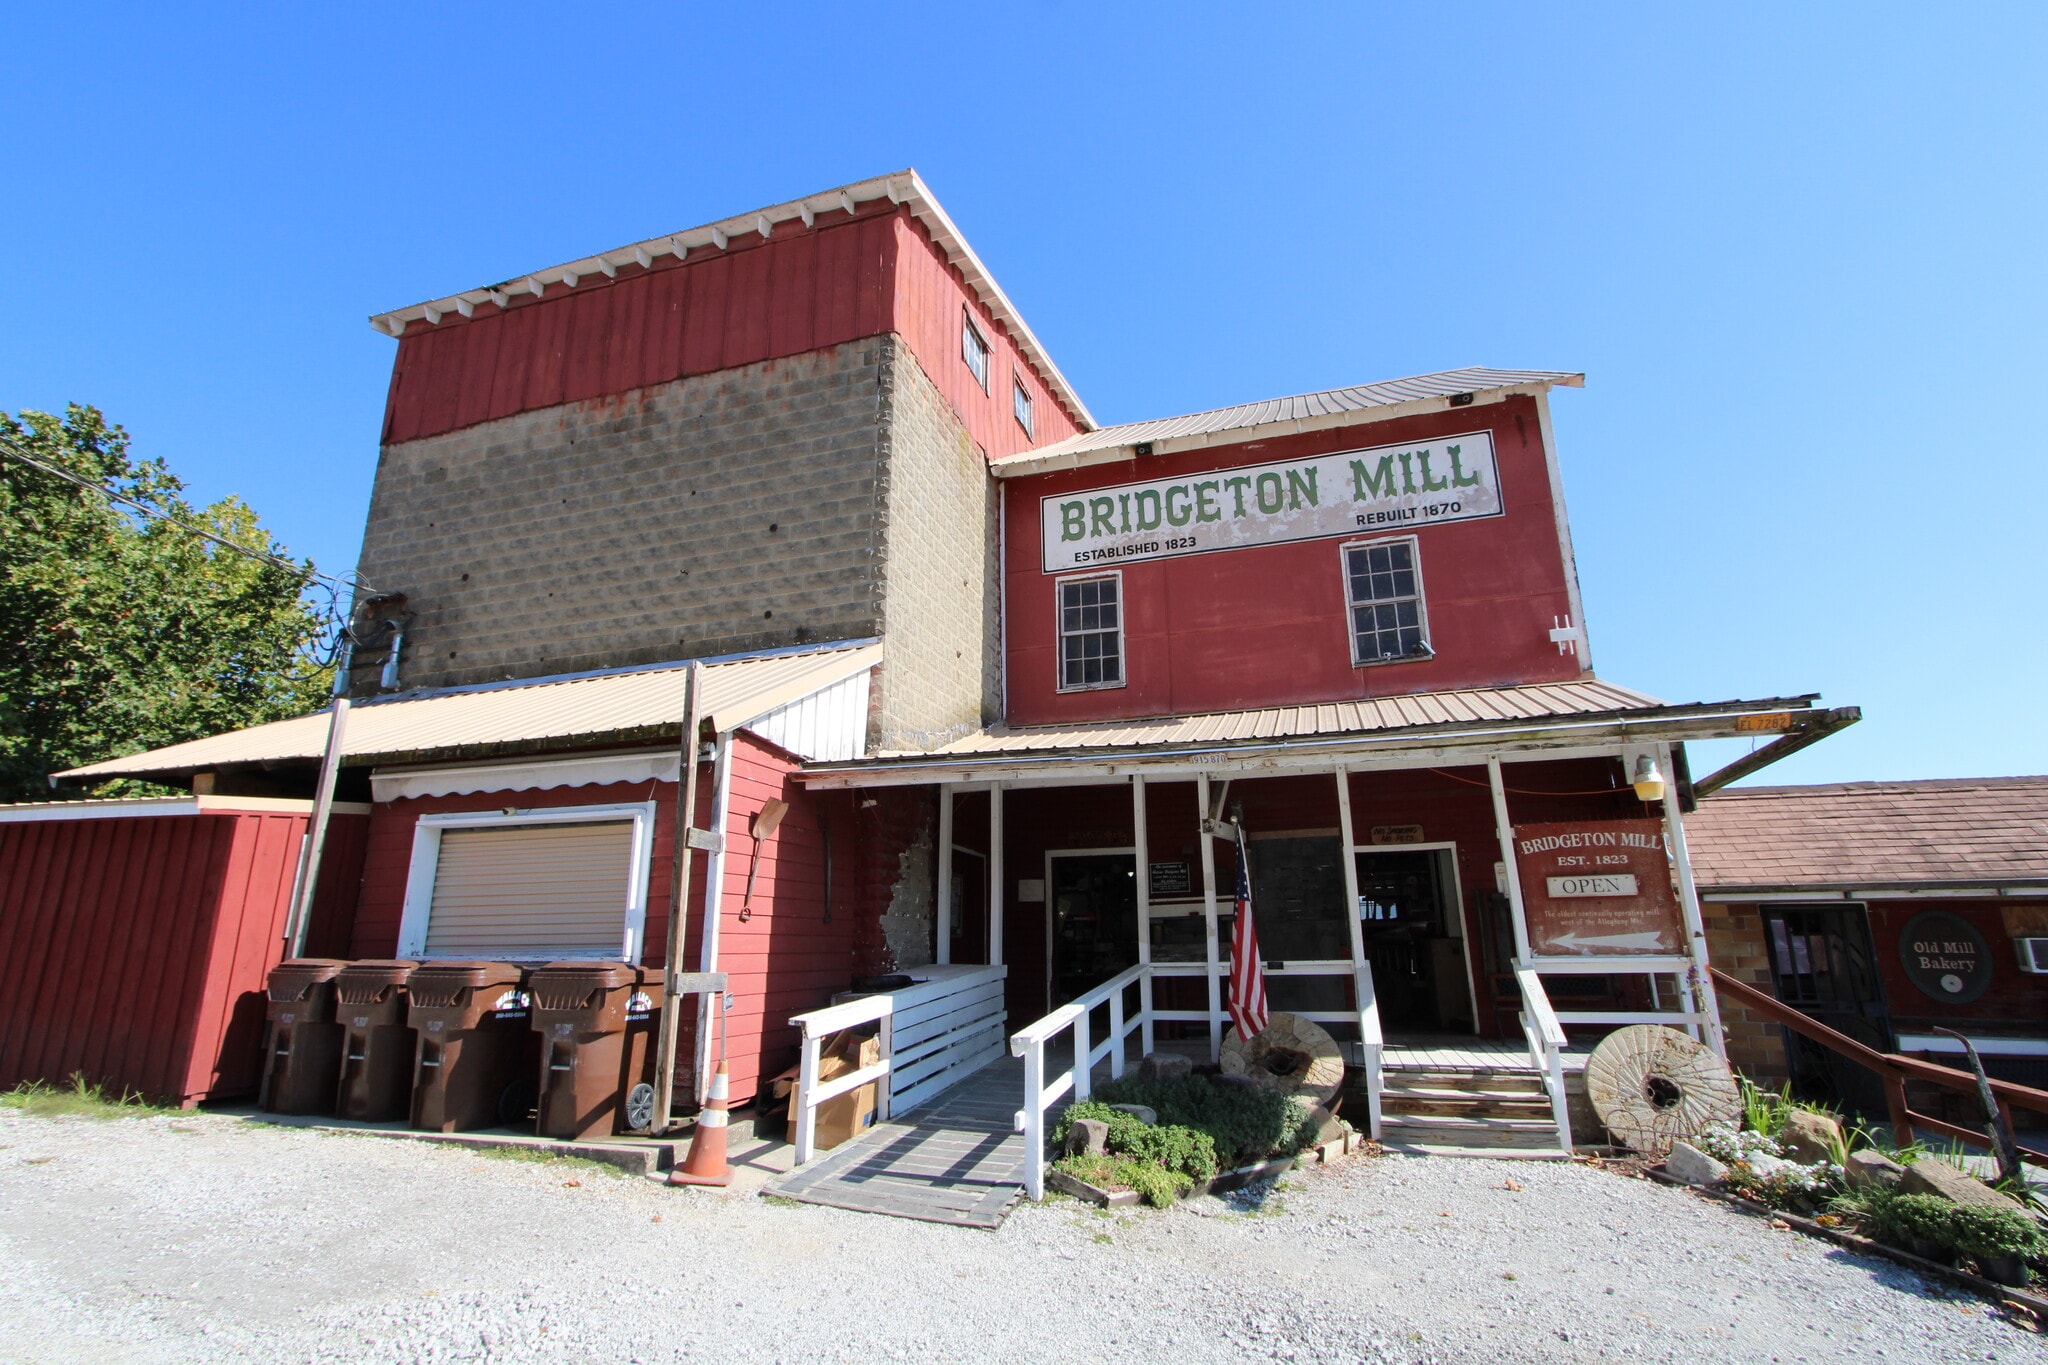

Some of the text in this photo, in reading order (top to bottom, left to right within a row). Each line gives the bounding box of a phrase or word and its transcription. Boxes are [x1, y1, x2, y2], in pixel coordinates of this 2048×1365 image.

[1060, 444, 1479, 542] BRIDGETON MILL
[1356, 501, 1462, 526] REBUILT 1870
[1074, 536, 1197, 562] ESTABLISHED 1823
[1757, 718, 1786, 730] 7282
[1521, 832, 1662, 855] BRIDGETON MILL
[1557, 855, 1628, 866] EST. 1823
[1562, 878, 1620, 894] OPEN
[1544, 910, 1555, 918] The
[1556, 910, 1576, 918] oldest
[1614, 908, 1644, 919] operating
[1576, 918, 1583, 926] of
[1585, 917, 1595, 926] the
[1913, 941, 1976, 954] Old Mill
[1918, 956, 1976, 973] Bakery
